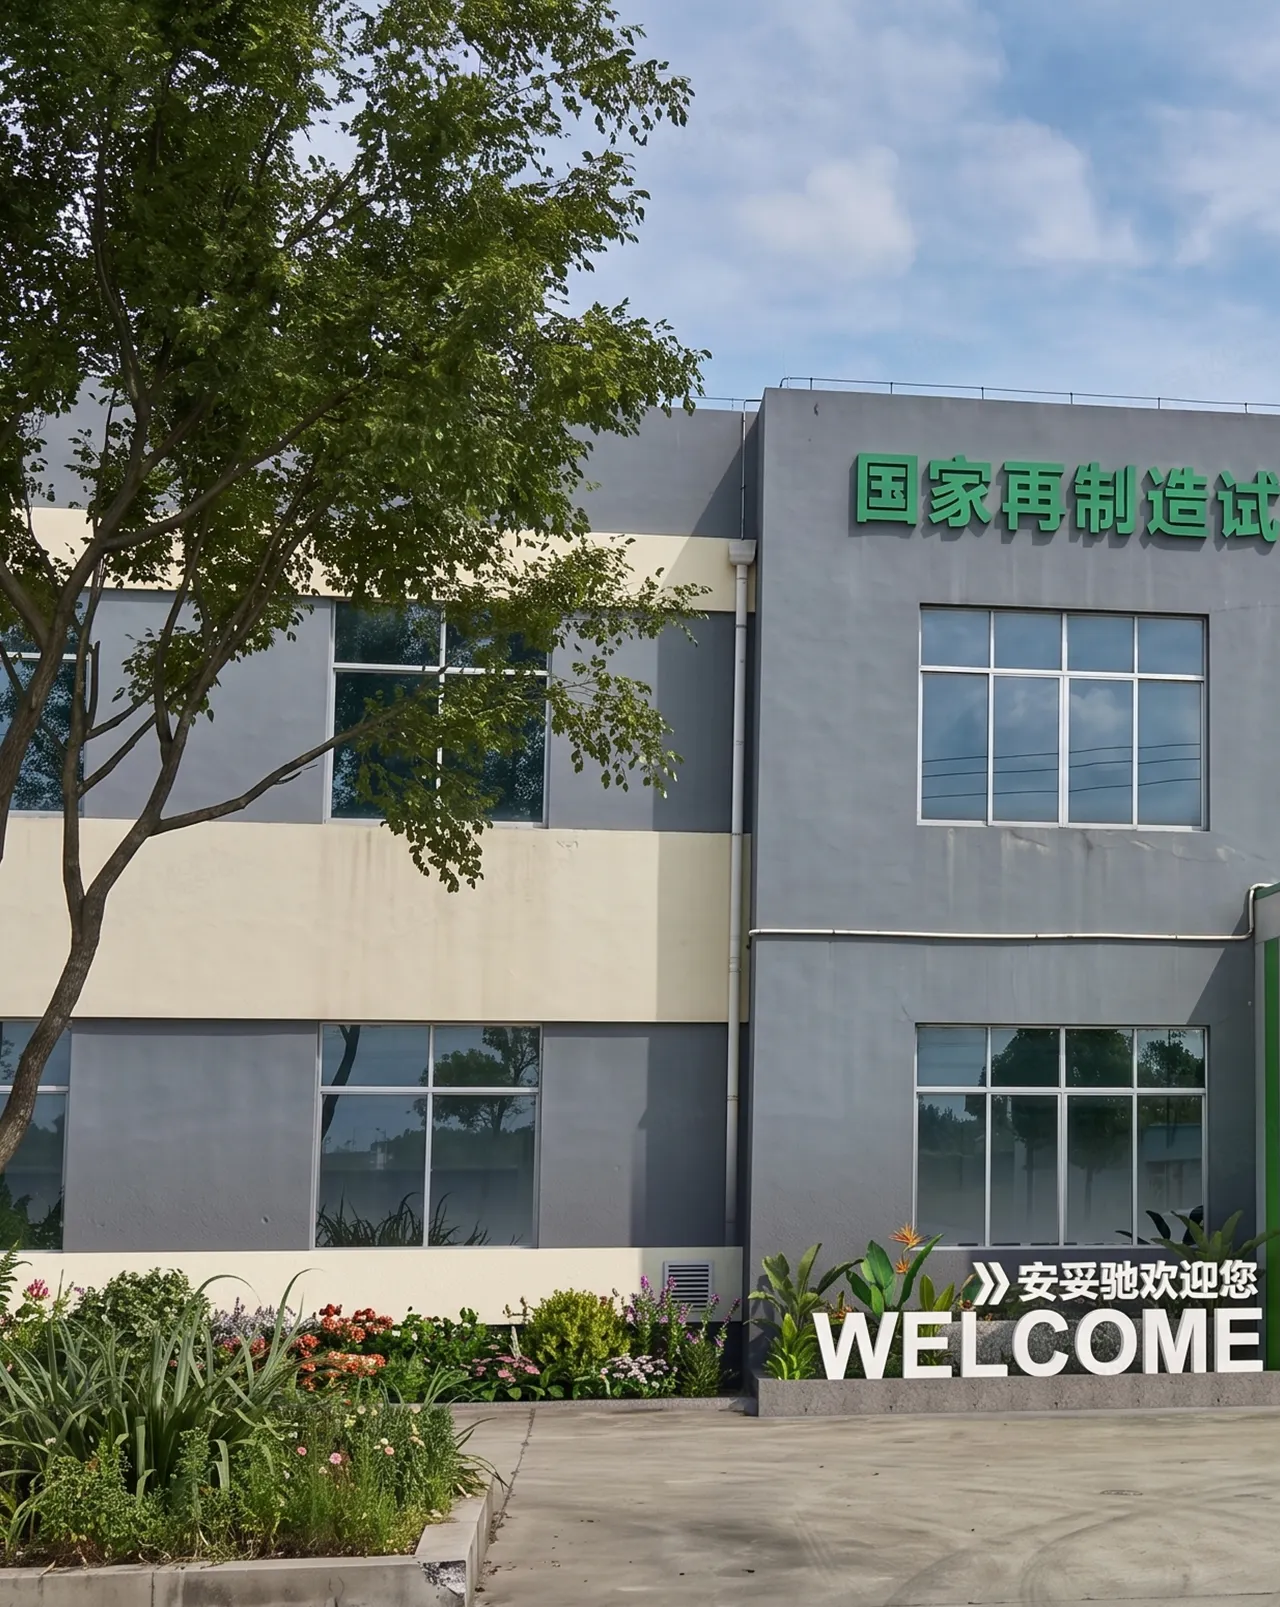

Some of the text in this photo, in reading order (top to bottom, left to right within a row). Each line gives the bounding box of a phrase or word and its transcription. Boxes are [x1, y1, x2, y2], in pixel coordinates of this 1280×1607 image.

[1017, 1260, 1258, 1302] 安妥驰欢迎您
[812, 1307, 1264, 1380] WELCOME
